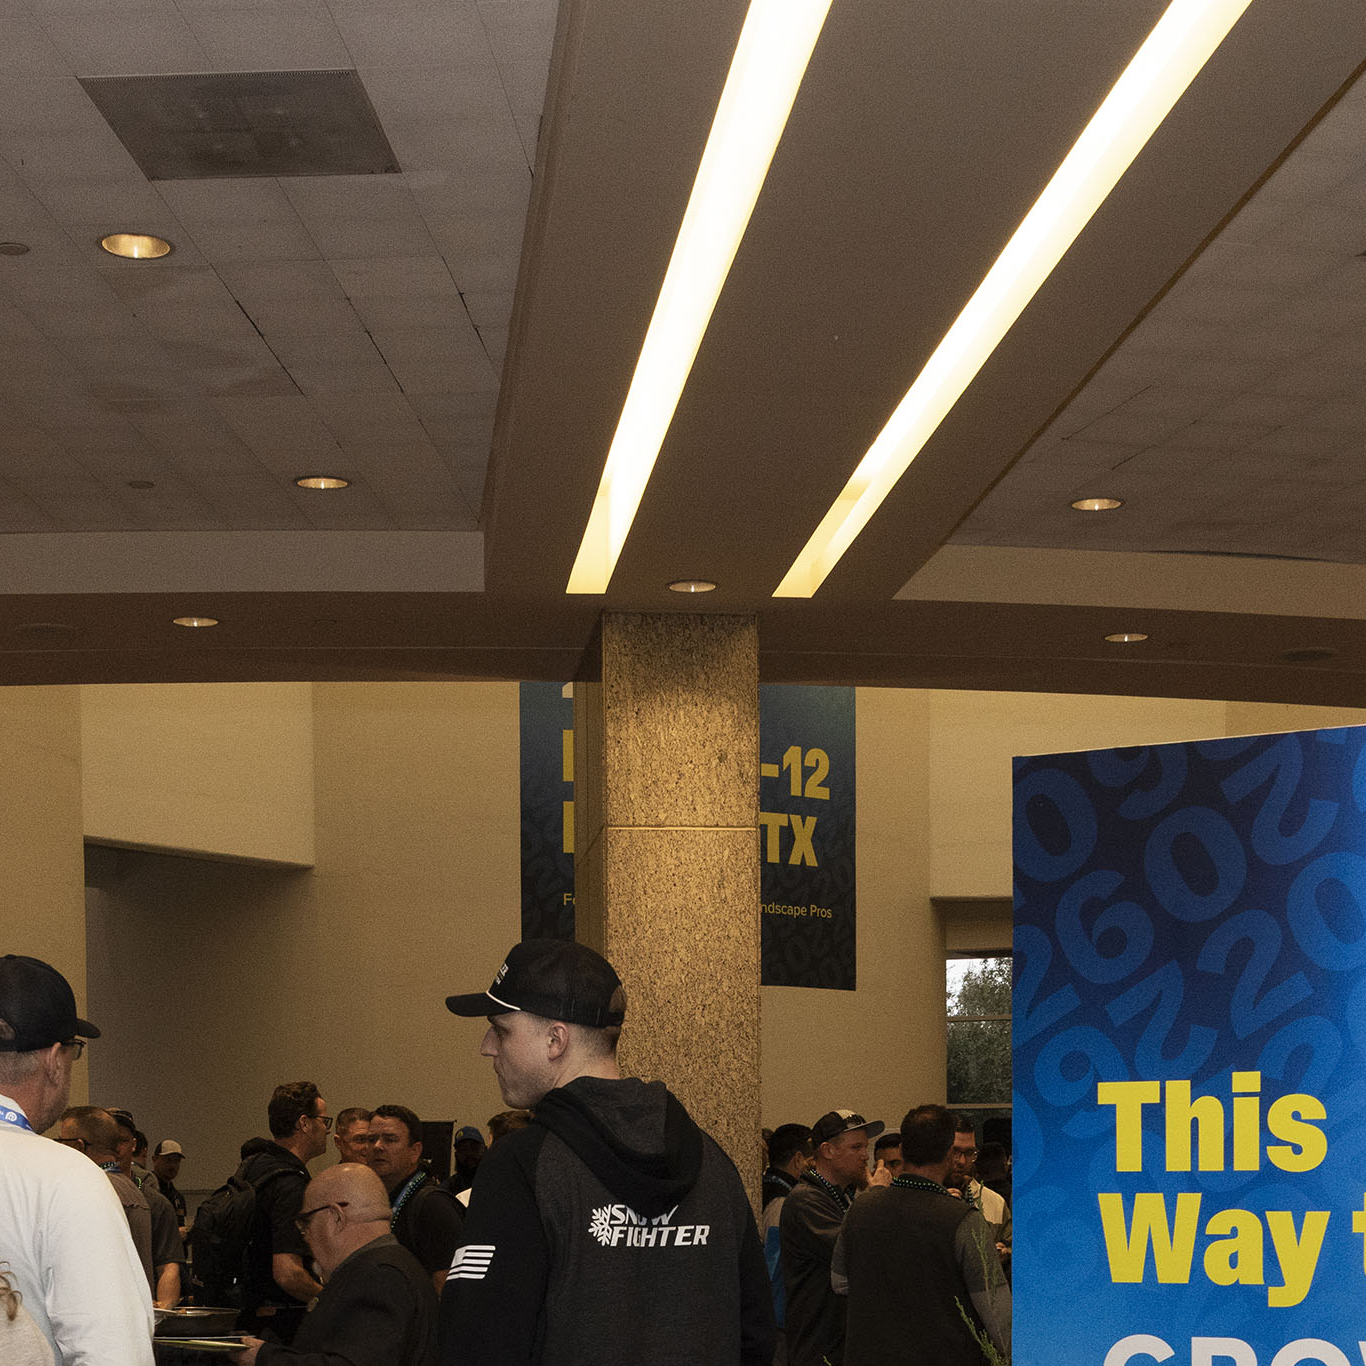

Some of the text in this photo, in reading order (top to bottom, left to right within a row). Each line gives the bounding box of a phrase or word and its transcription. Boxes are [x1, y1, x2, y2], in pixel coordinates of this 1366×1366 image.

[760, 746, 830, 800] -12
[760, 811, 819, 867] TX
[761, 901, 833, 919] ndscape Pros
[1097, 1070, 1328, 1173] This
[610, 1225, 710, 1247] FIGHTER
[1097, 1192, 1332, 1308] Way
